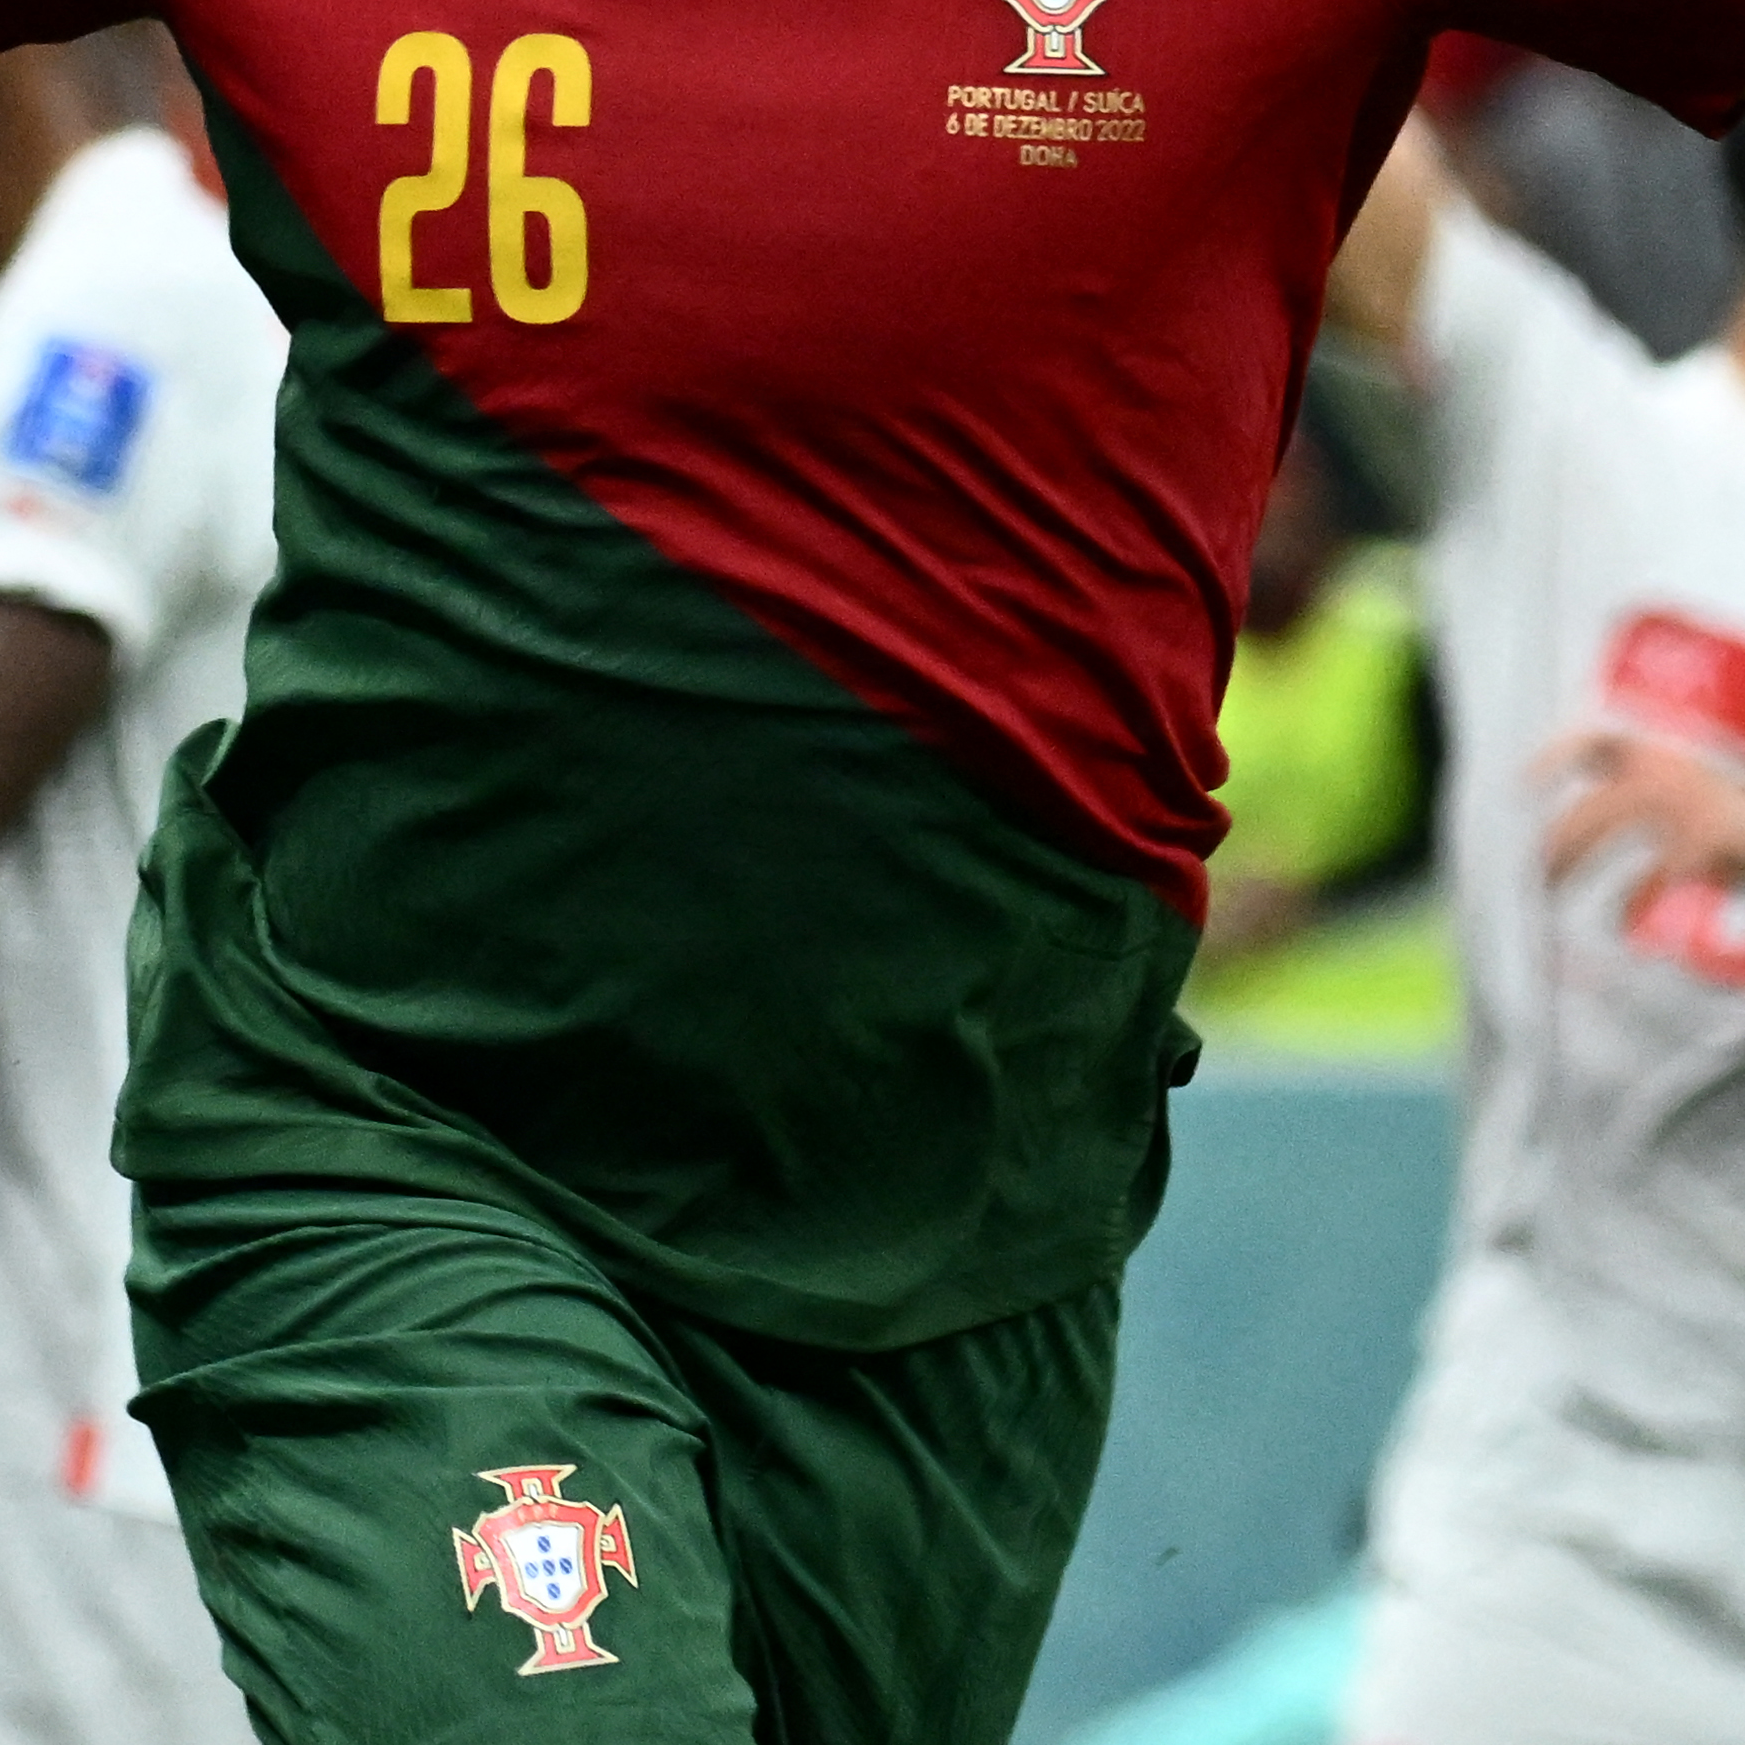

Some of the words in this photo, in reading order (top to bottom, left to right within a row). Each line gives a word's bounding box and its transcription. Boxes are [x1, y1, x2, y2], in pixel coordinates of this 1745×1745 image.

[947, 85, 1062, 112] PORTUGAL
[945, 112, 960, 135] 6
[964, 113, 989, 137] DE
[993, 115, 1093, 141] DEZEMBRO
[1096, 119, 1146, 142] 2022
[1020, 144, 1078, 167] DOHA
[375, 31, 592, 324] 26
